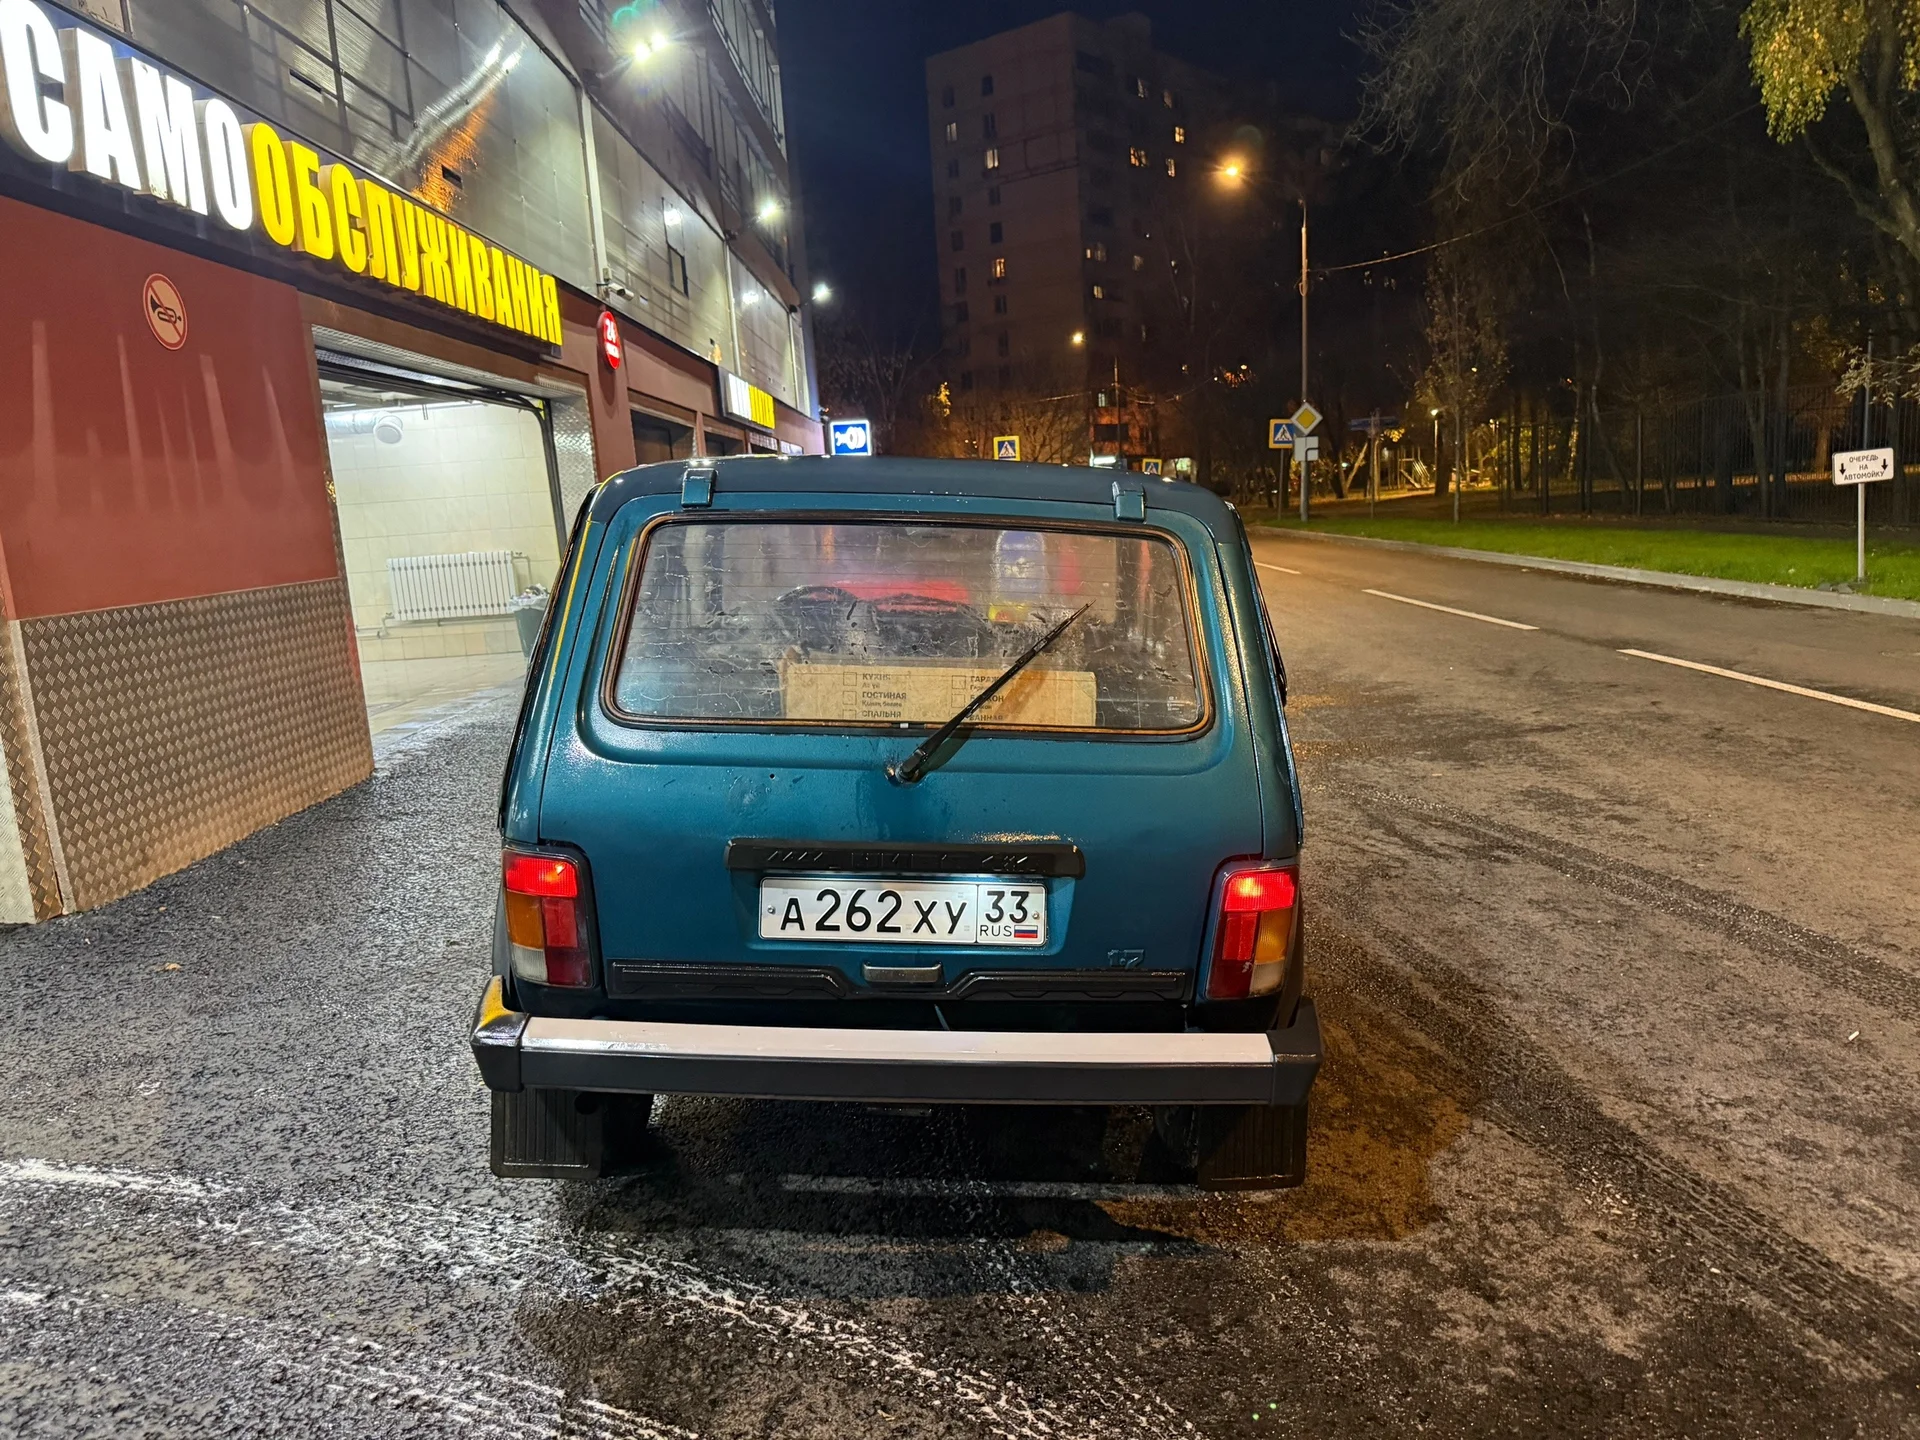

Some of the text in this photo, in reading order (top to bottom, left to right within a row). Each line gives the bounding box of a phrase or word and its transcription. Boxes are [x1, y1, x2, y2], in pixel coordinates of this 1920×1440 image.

[0, 0, 563, 346] САМООБСЛУЖИВАНИЯ
[1849, 455, 1879, 463] ОЧЕРЕДЬ
[1844, 471, 1885, 481] АВТОМОЙКУ
[862, 691, 907, 700] ГОСТИНАЯ
[862, 710, 902, 719] СПАЛЬНЯ
[984, 890, 1030, 924] 33
[979, 924, 1013, 938] RUS
